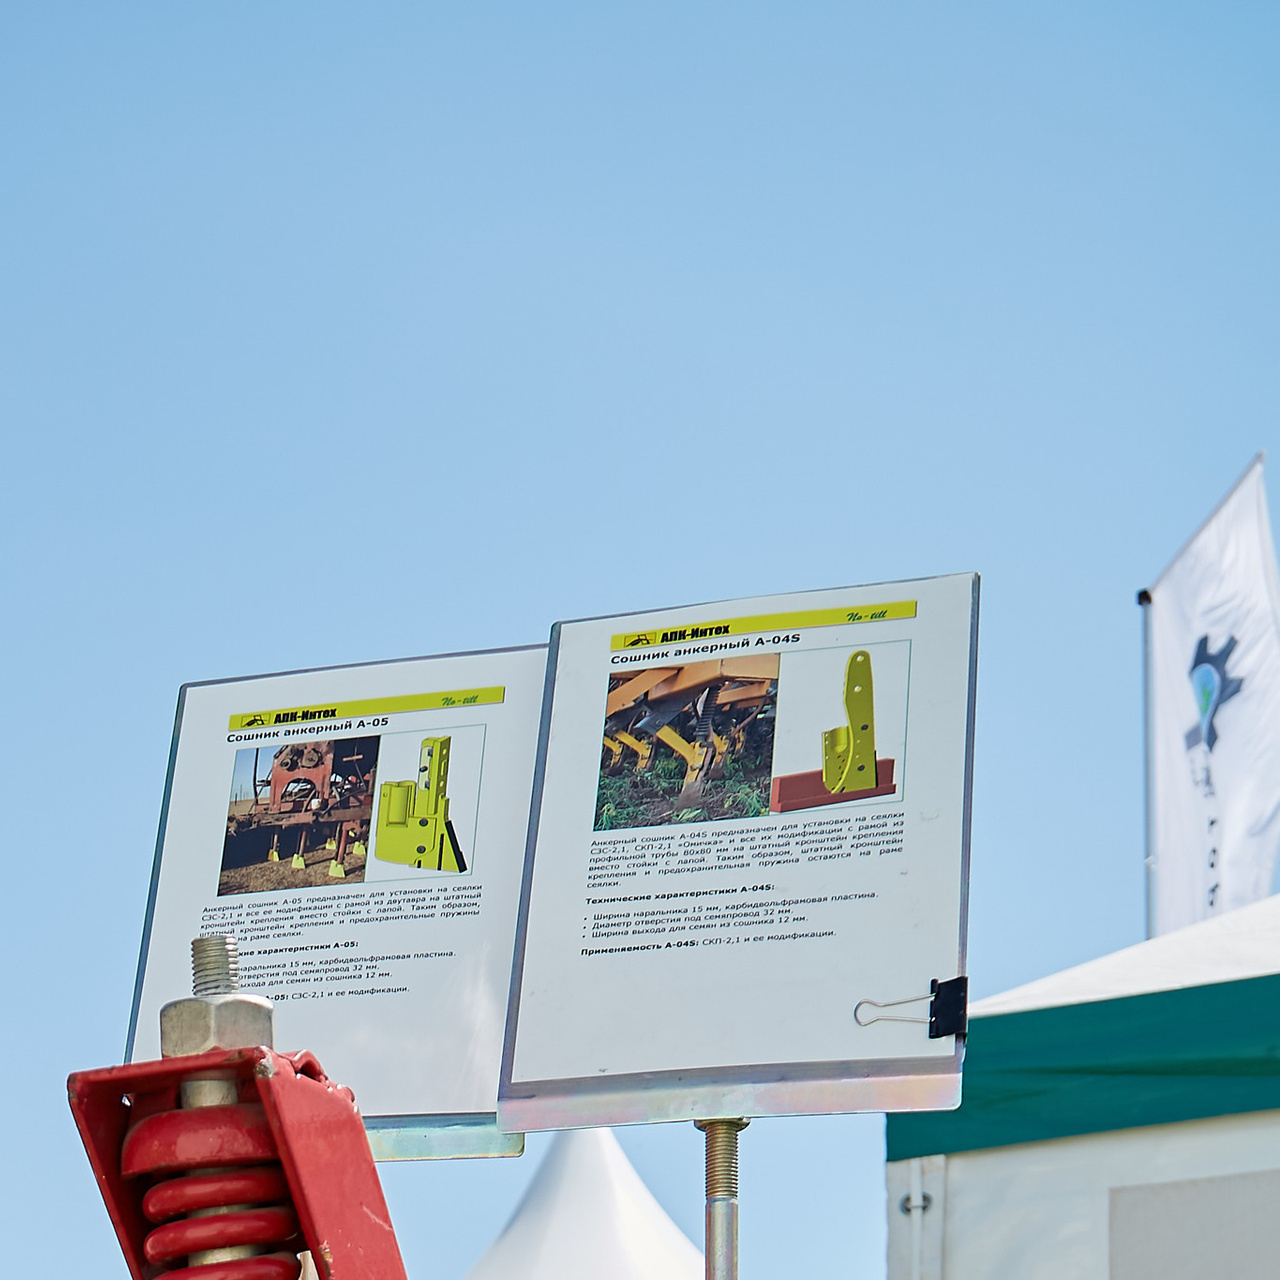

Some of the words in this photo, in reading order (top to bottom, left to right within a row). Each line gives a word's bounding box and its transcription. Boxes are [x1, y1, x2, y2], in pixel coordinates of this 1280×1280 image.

[610, 650, 670, 664] Сошник
[673, 637, 750, 657] анкерный
[226, 730, 280, 743] Сошник
[283, 720, 352, 737] анкерный
[590, 837, 637, 847] Анкерный
[640, 835, 676, 843] сошник
[711, 825, 778, 838] предназначен
[780, 823, 798, 832] для
[802, 817, 851, 829] установки
[870, 812, 905, 821] сеялки
[677, 839, 724, 848] «Омичка»
[777, 827, 843, 839] модификации
[858, 821, 888, 832] рамой
[588, 864, 620, 872] вместо
[626, 861, 658, 869] стойки
[677, 856, 708, 865] лапой.
[716, 854, 745, 862] Таким
[751, 849, 793, 859] образом,
[801, 843, 843, 854] штатный
[850, 837, 904, 850] кронштейн
[589, 852, 646, 864] профильной
[651, 850, 679, 859] трубы
[749, 840, 791, 851] штатный
[795, 834, 848, 847] кронштейн
[852, 829, 904, 841] крепления
[587, 871, 637, 881] крепления
[658, 862, 751, 876] предохранительная
[758, 857, 800, 867] пружина
[807, 852, 852, 862] остаются
[879, 846, 903, 856] раме
[586, 880, 622, 889] сеялки.
[202, 903, 244, 914] Анкерный
[247, 900, 279, 909] сошник
[306, 893, 366, 904] предназначен
[368, 891, 385, 899] для
[389, 888, 433, 897] установки
[452, 884, 483, 892] сеялки
[276, 904, 333, 914] модификации
[344, 899, 371, 909] рамой
[386, 896, 426, 906] двутавра
[443, 891, 482, 901] штатный
[585, 894, 652, 905] Технические
[654, 888, 738, 900] характеристики
[593, 912, 631, 921] Ширина
[633, 908, 689, 918] наральника
[692, 905, 703, 913] 15
[725, 896, 828, 911] карбидвольфрамовая
[831, 892, 879, 901] пластина.
[200, 919, 246, 930] кронштейн
[250, 915, 294, 925] крепления
[299, 912, 328, 920] вместо
[332, 909, 362, 917] стойки
[376, 905, 405, 914] лапой.
[441, 901, 481, 910] образом,
[239, 923, 285, 934] кронштейн
[289, 920, 335, 930] крепления
[349, 912, 436, 925] предохранительные
[440, 910, 480, 918] пружины
[591, 920, 632, 930] Диаметр
[634, 917, 682, 926] отверстия
[704, 911, 760, 921] семяпровод
[763, 908, 775, 916] 32
[591, 930, 629, 938] Ширина
[631, 927, 666, 935] выхода
[668, 925, 686, 933] для
[688, 923, 717, 931] семян
[733, 918, 775, 927] сошника
[778, 915, 790, 924] 12
[249, 933, 271, 942] раме
[272, 931, 304, 939] сеялки.
[580, 944, 663, 957] Применяемость
[767, 930, 837, 941] модификации.
[257, 944, 331, 956] характеристики
[290, 960, 300, 968] 15
[319, 953, 411, 966] карбидвольфрамовая
[413, 951, 456, 959] пластина.
[238, 972, 280, 982] отверстия
[299, 966, 350, 976] семяпровод
[267, 979, 284, 987] для
[285, 977, 311, 985] семян
[325, 973, 363, 982] сошника
[366, 971, 376, 979] 12
[348, 986, 410, 996] модификации.
